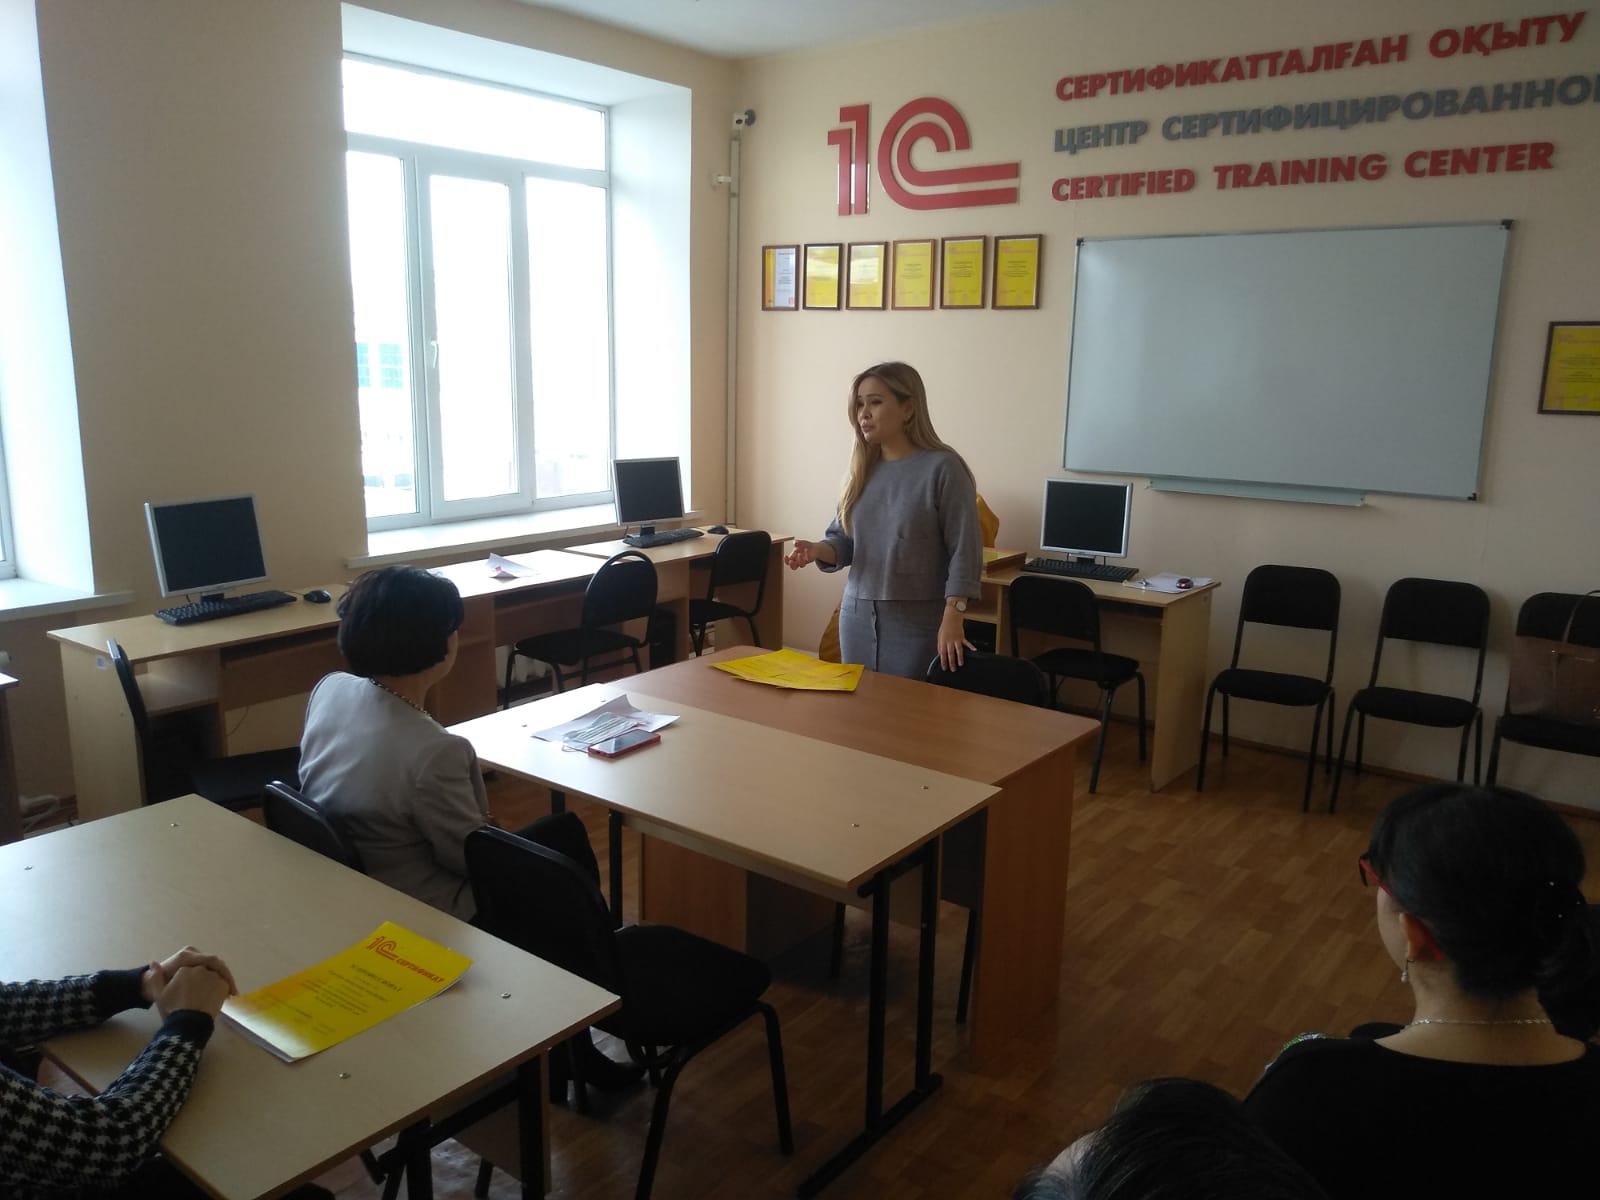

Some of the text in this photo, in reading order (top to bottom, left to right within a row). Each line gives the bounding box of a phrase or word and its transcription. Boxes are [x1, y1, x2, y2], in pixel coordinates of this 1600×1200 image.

[1056, 11, 1587, 101] СЕРТИФИКАТТАЛҒАН ОҚЫТУ
[1054, 120, 1149, 155] ЦЕНТР
[1051, 142, 1555, 201] CERTIFIED TRAINING CENTER
